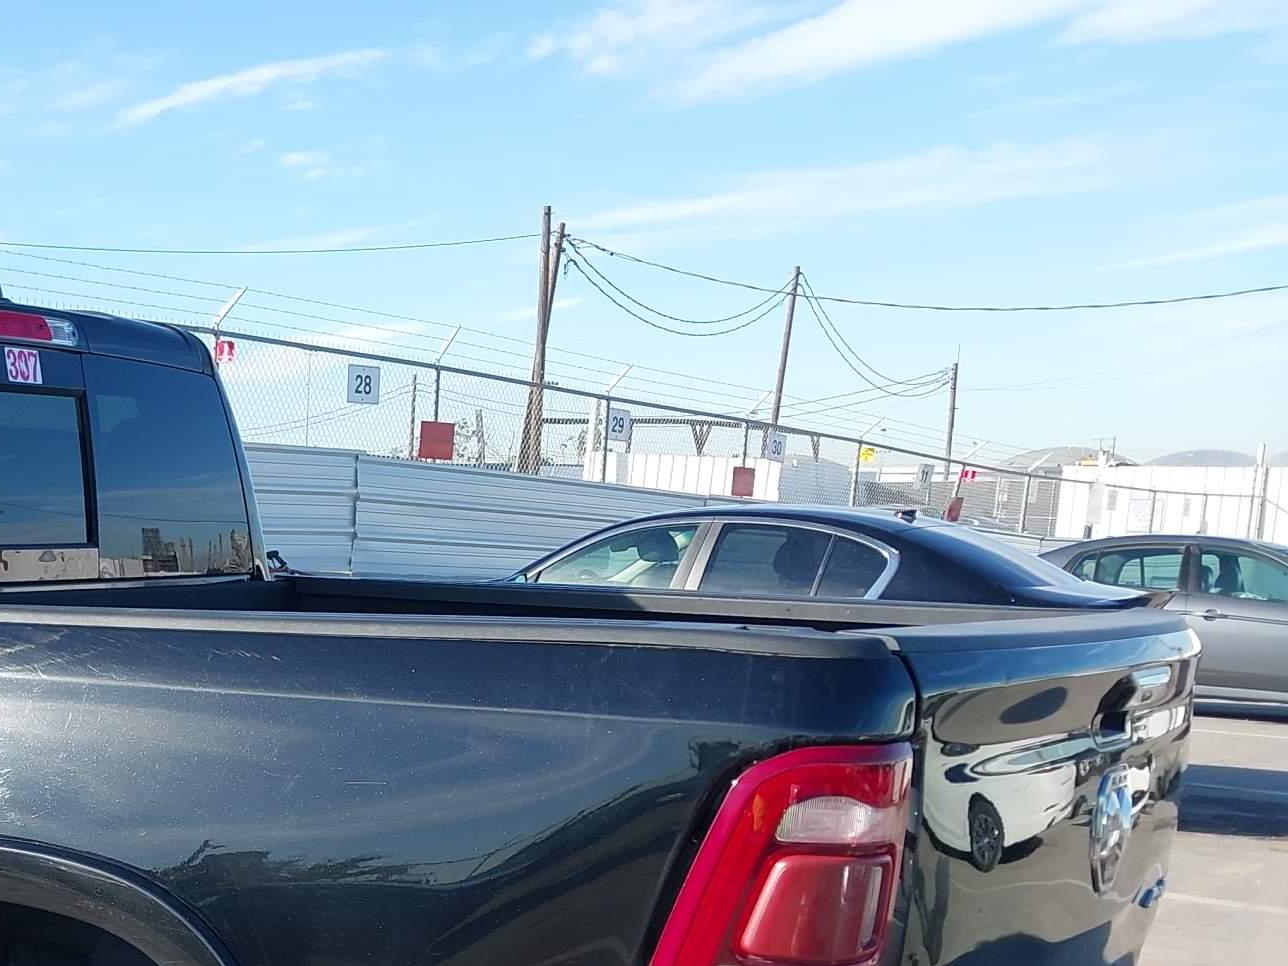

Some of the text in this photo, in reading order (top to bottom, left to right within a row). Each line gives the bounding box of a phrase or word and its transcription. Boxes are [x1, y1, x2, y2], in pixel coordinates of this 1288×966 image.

[6, 349, 38, 383] 307
[354, 374, 372, 395] 28
[611, 415, 625, 434] 29
[771, 439, 782, 456] 30
